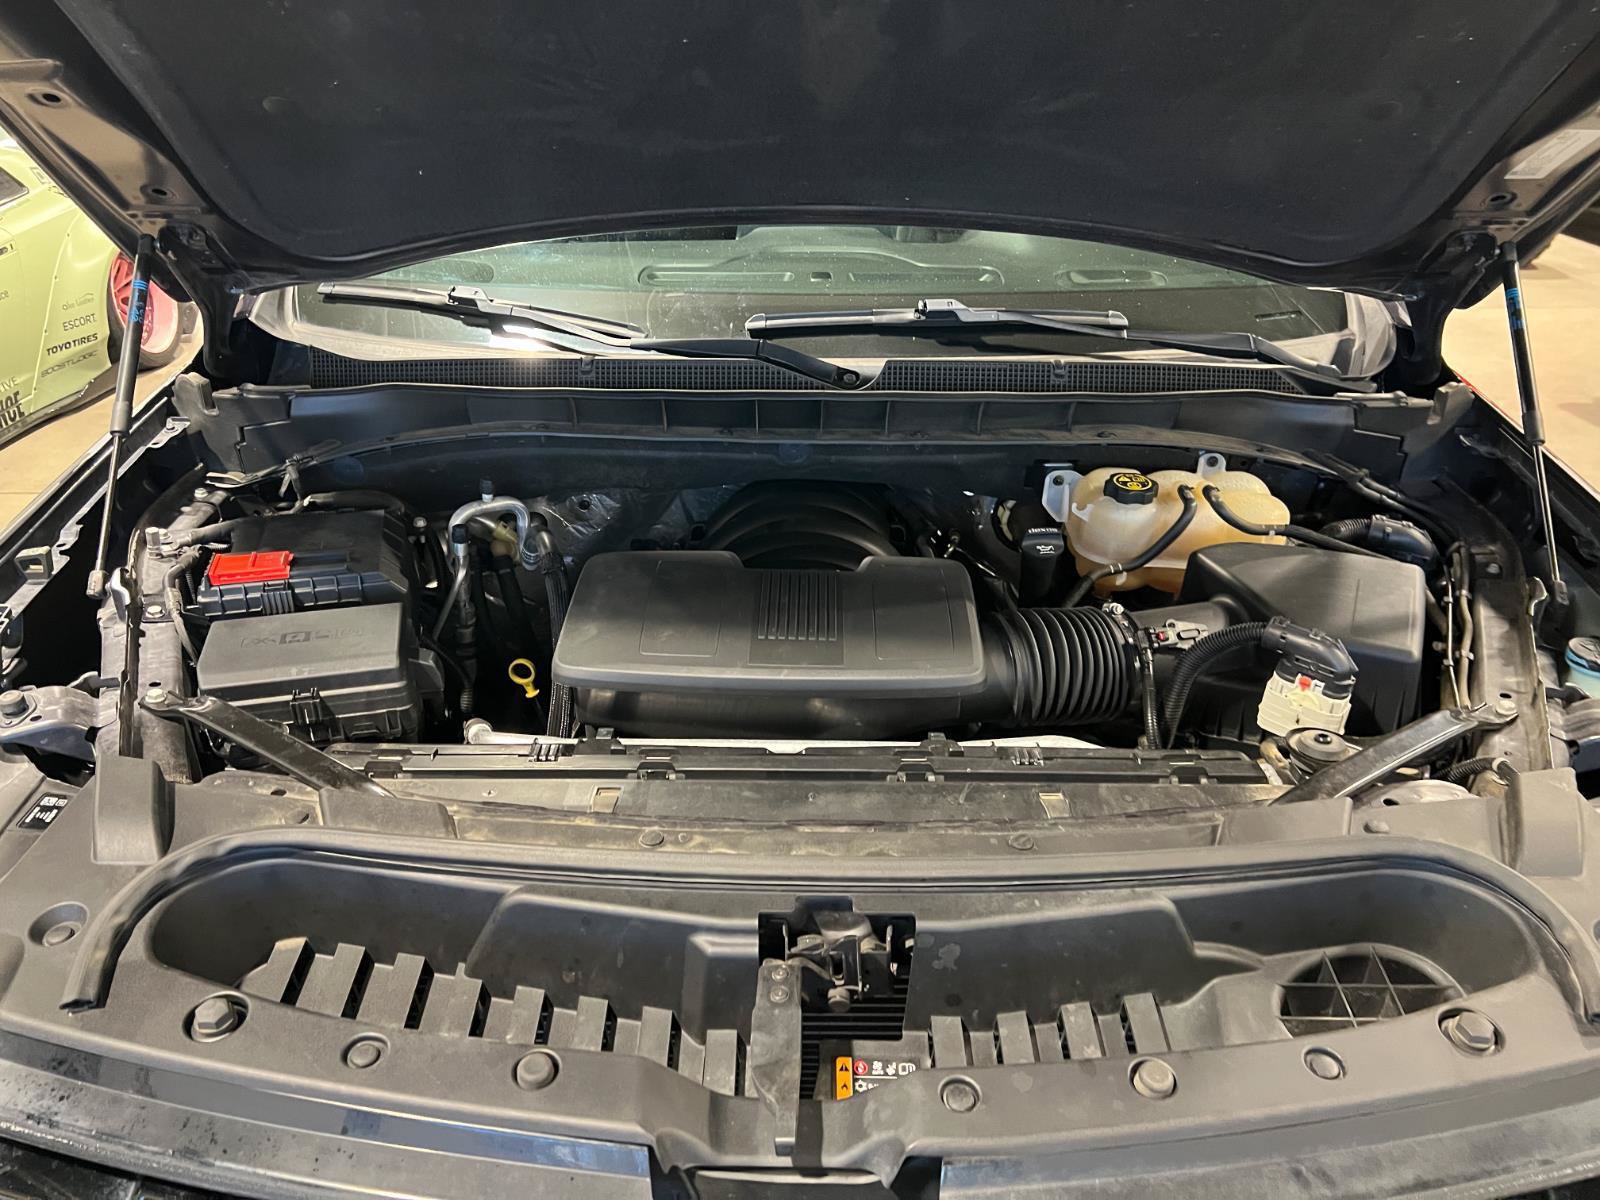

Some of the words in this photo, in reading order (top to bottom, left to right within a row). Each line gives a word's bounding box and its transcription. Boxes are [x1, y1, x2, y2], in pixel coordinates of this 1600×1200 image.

[62, 313, 97, 331] ESCORT
[46, 341, 72, 356] TOYO
[72, 333, 98, 347] TIRES
